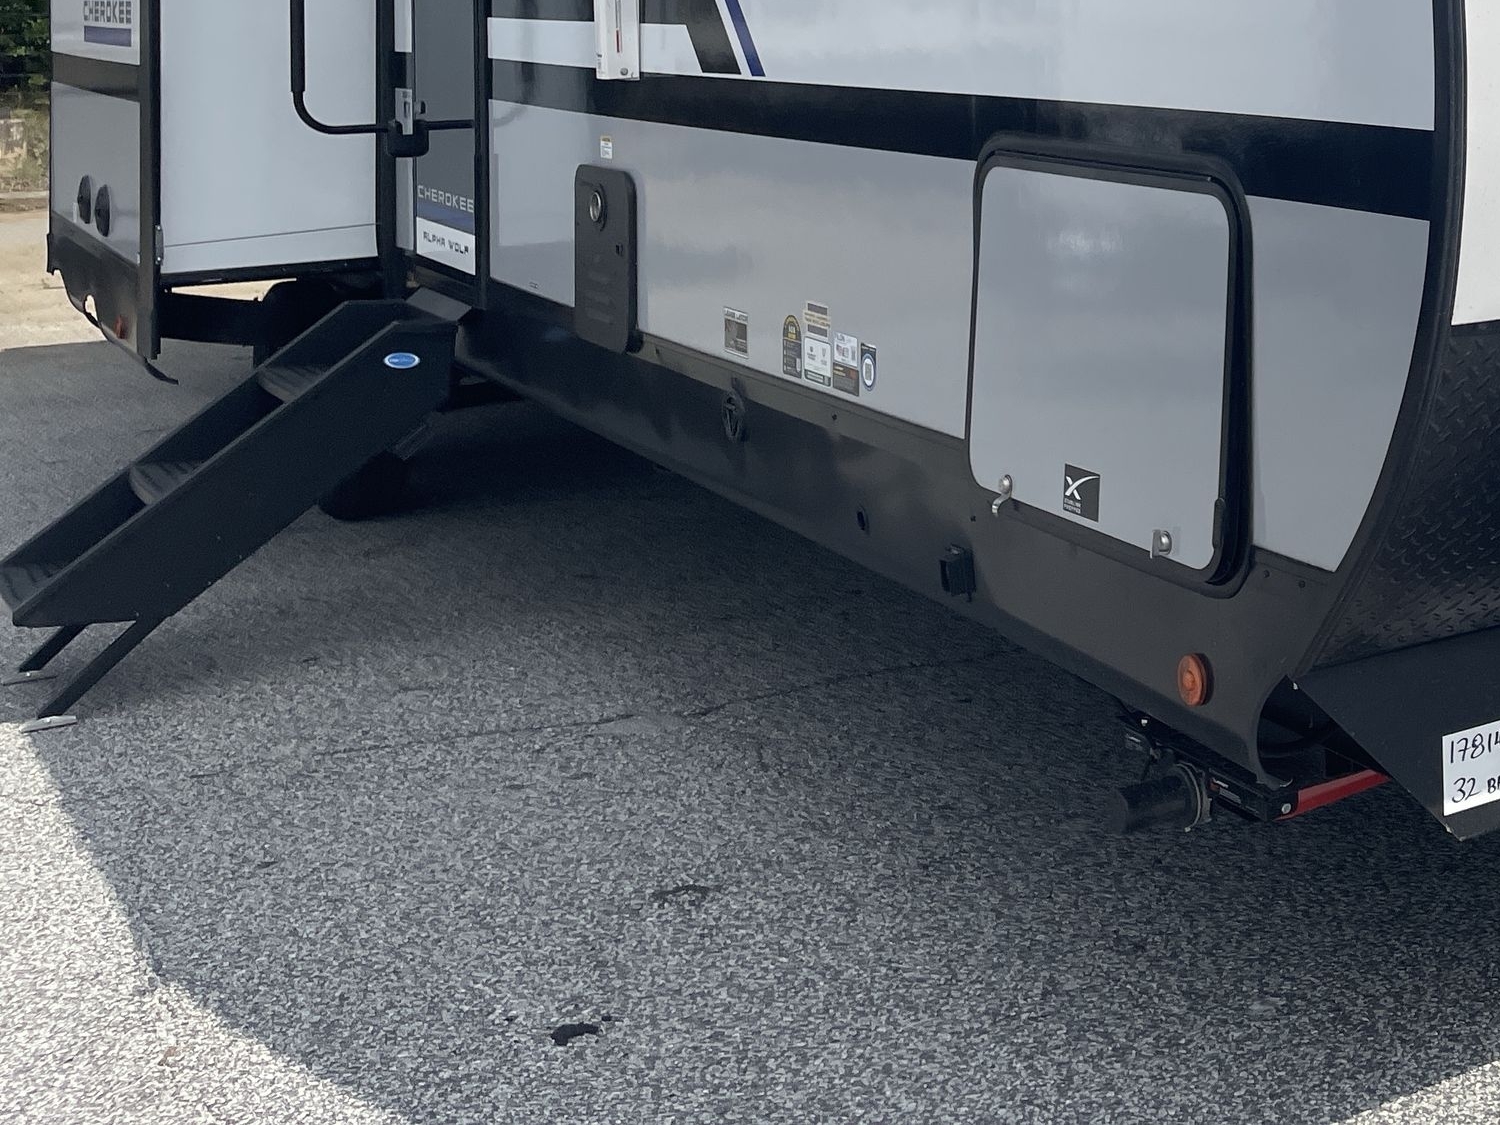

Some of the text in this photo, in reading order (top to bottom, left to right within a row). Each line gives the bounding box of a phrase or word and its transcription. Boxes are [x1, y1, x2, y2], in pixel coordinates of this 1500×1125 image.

[83, 0, 132, 24] CHEROKEE
[416, 184, 475, 213] CHEROKEE
[423, 231, 469, 255] ALPHA WOLF
[1451, 777, 1482, 804] 32
